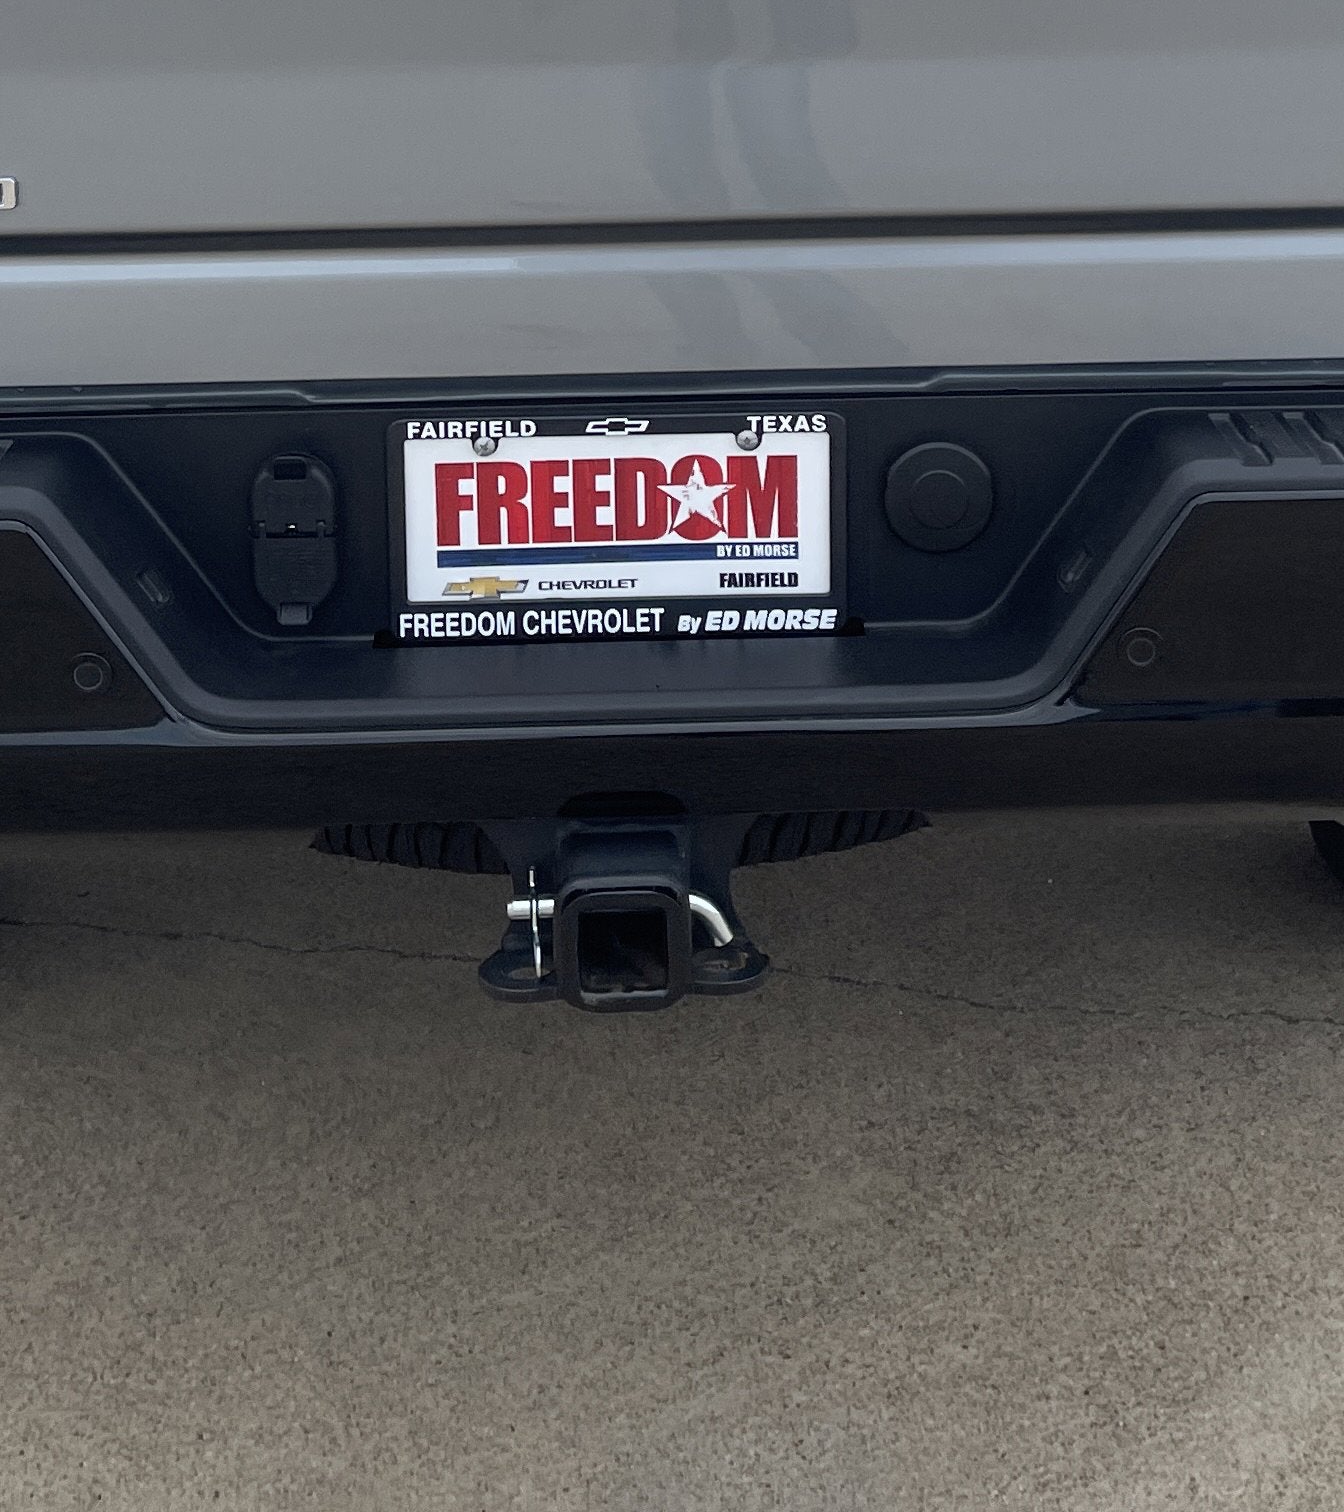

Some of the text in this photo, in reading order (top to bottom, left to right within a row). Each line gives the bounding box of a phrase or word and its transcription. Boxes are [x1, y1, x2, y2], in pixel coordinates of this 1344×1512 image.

[407, 420, 536, 439] FAIRFIELD
[747, 414, 827, 433] TEXAS
[435, 454, 798, 546] FREEDOM
[716, 544, 796, 557] BY ED MORSE
[538, 577, 638, 591] CHEVROLET
[719, 572, 798, 588] FAIRFIELD
[399, 607, 838, 638] FREEDOM CHEVROLET By ED MORSE
